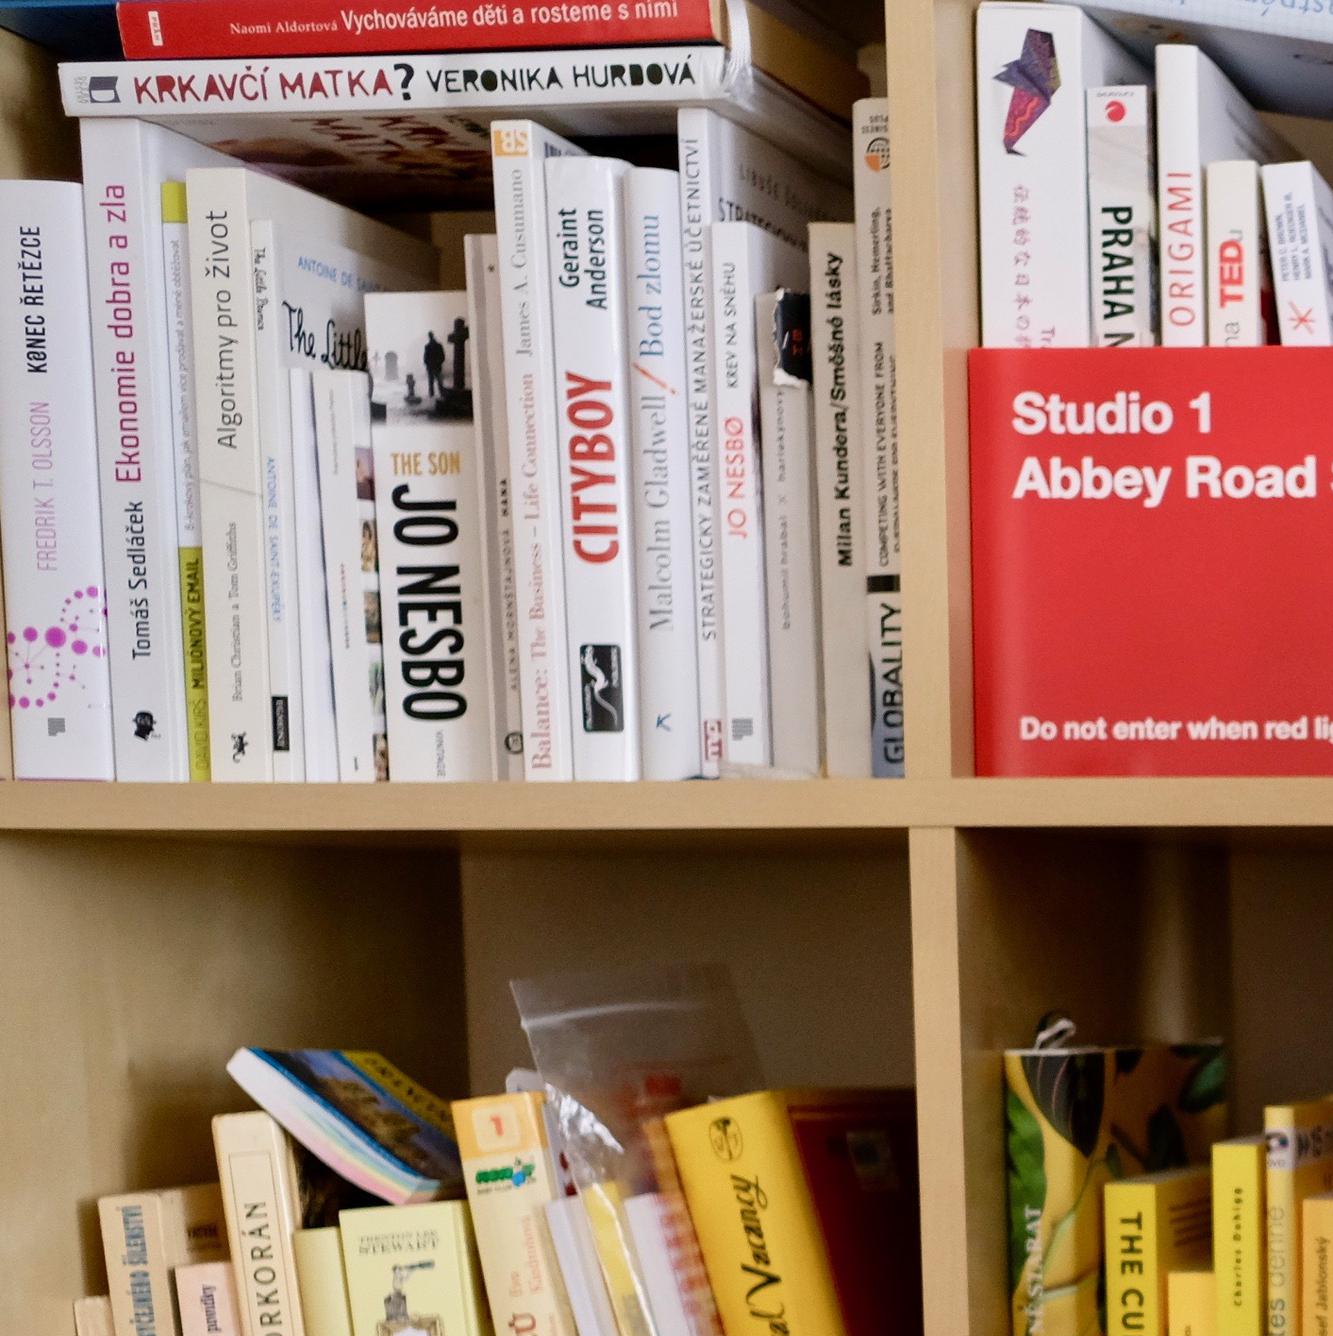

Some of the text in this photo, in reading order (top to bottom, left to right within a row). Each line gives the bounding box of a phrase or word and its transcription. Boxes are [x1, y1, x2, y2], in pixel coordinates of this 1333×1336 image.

[230, 0, 678, 35] Naomi Aldortová Vychováváme děti a rosteme s nimi
[134, 55, 696, 104] KRKAVČÍ MATKA? VERONIKA HURDOVÁ
[558, 207, 578, 288] Geraint
[585, 208, 607, 309] Anderson
[1101, 207, 1135, 320] PRAHA
[1167, 172, 1195, 326] ORIGAMI
[1220, 239, 1244, 309] TED
[213, 290, 238, 330] pro
[100, 184, 152, 660] Tomáš Sedláček Ekonomie dobra a zla
[213, 337, 243, 449] Algoritmy
[637, 214, 673, 630] Malcolm Gladwell Bod zlomu
[1012, 391, 1210, 435] Studio 1
[391, 452, 461, 475] THE SON
[566, 371, 619, 564] CITYBOY
[1012, 456, 1171, 507] Abbey
[1186, 456, 1316, 498] Road
[391, 484, 468, 720] JO NESBO
[1020, 716, 1056, 740] Do
[1064, 718, 1106, 740] not
[1114, 720, 1181, 741] enter
[1188, 718, 1258, 740] when
[1265, 716, 1307, 741] red
[730, 1174, 782, 1304] Vacancy
[1118, 1210, 1144, 1284] THE
